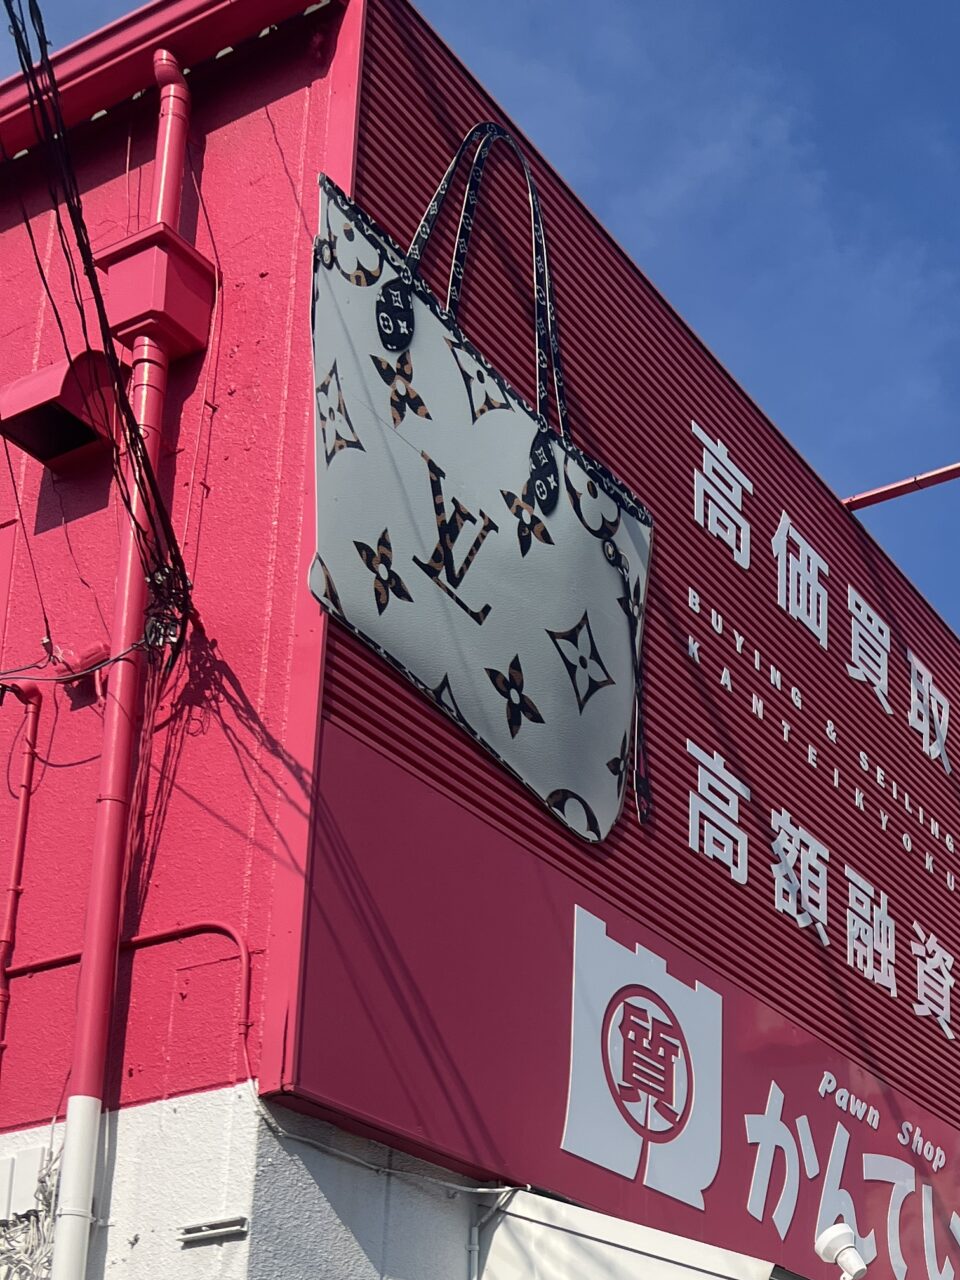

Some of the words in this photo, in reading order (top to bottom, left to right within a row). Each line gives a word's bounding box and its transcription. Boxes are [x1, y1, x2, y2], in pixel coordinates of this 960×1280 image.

[688, 586, 802, 710] BUYING
[691, 420, 952, 774] 高価買取
[686, 738, 956, 1041] 高額融資
[617, 1000, 681, 1123] 質
[818, 1071, 880, 1130] Pawn
[896, 1120, 946, 1172] Shop
